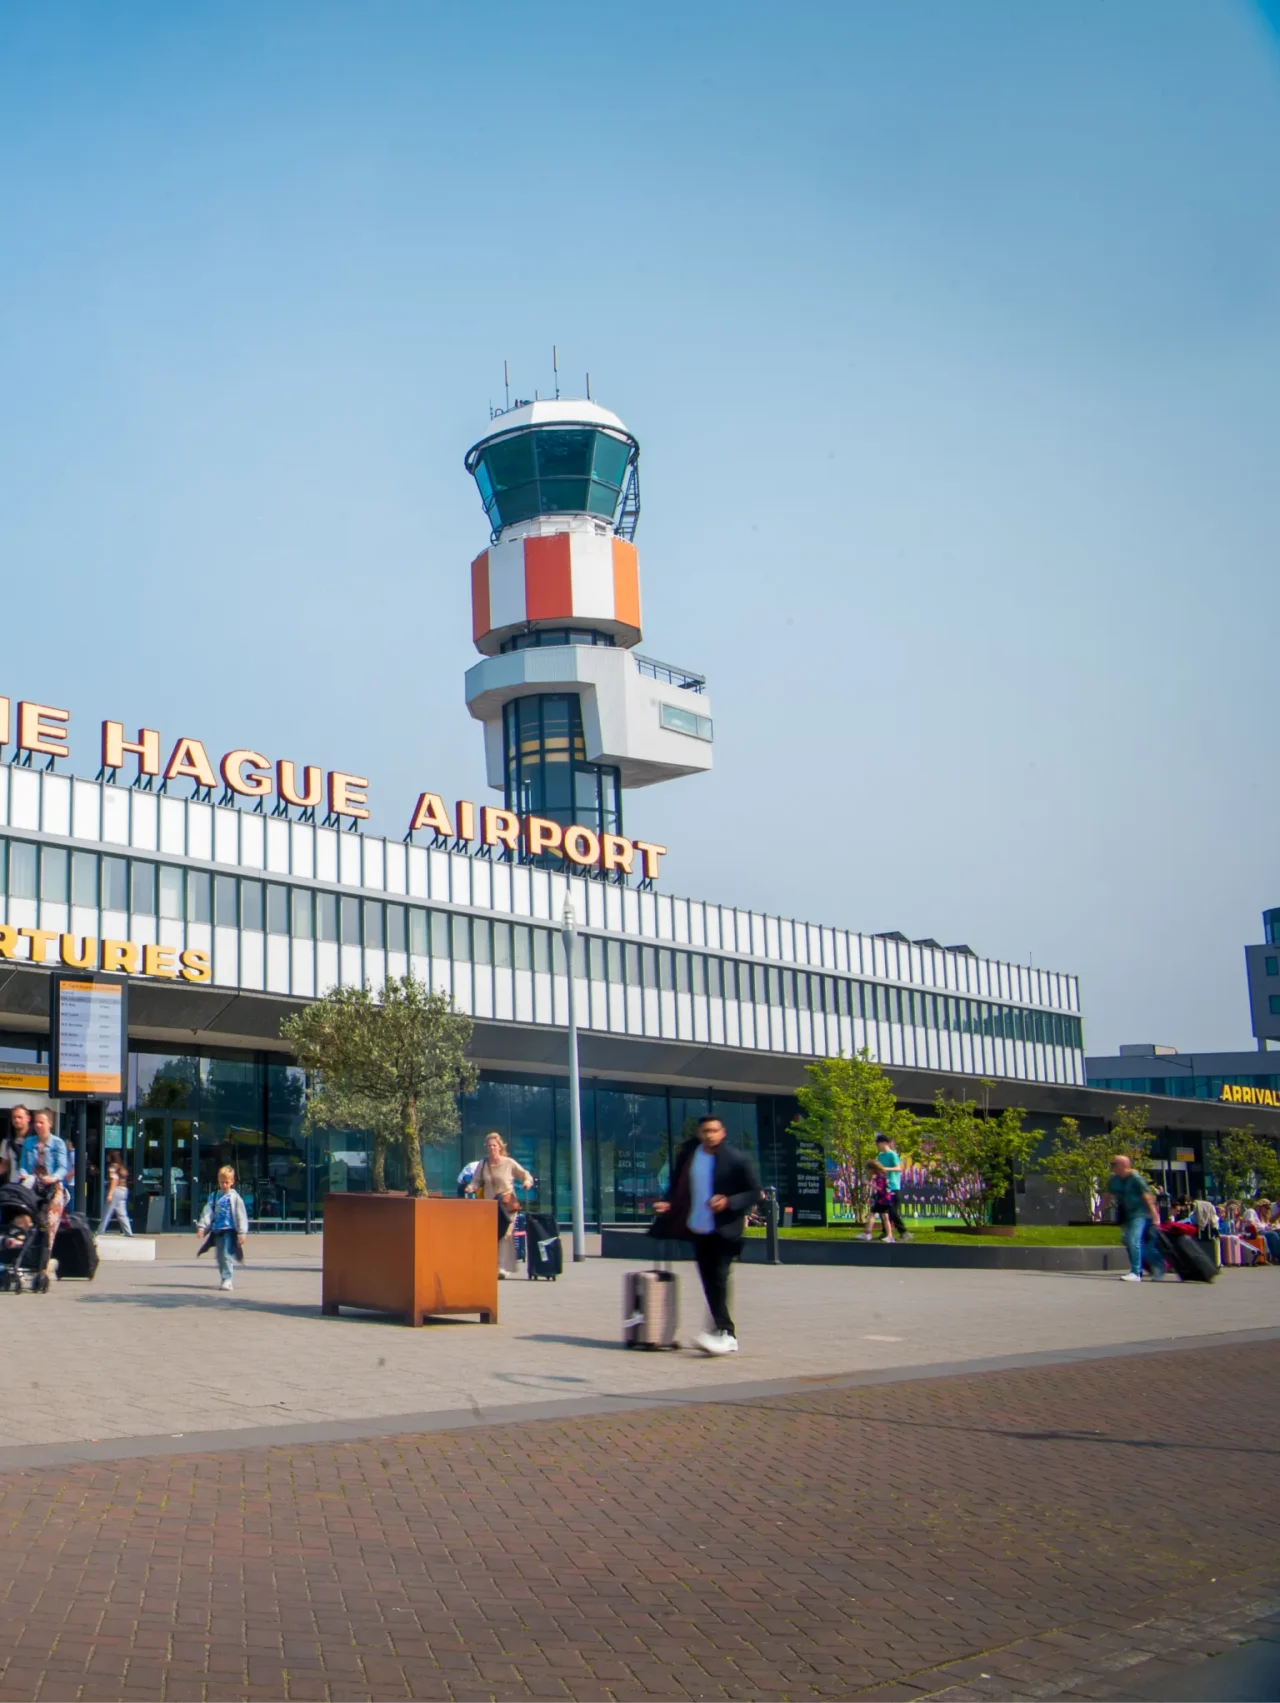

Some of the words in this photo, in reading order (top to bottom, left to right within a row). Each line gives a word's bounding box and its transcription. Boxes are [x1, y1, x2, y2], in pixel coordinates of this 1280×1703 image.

[101, 719, 370, 820] HAGUE
[409, 792, 668, 879] AIRPORT
[1222, 1084, 1280, 1107] ARRIVAL
